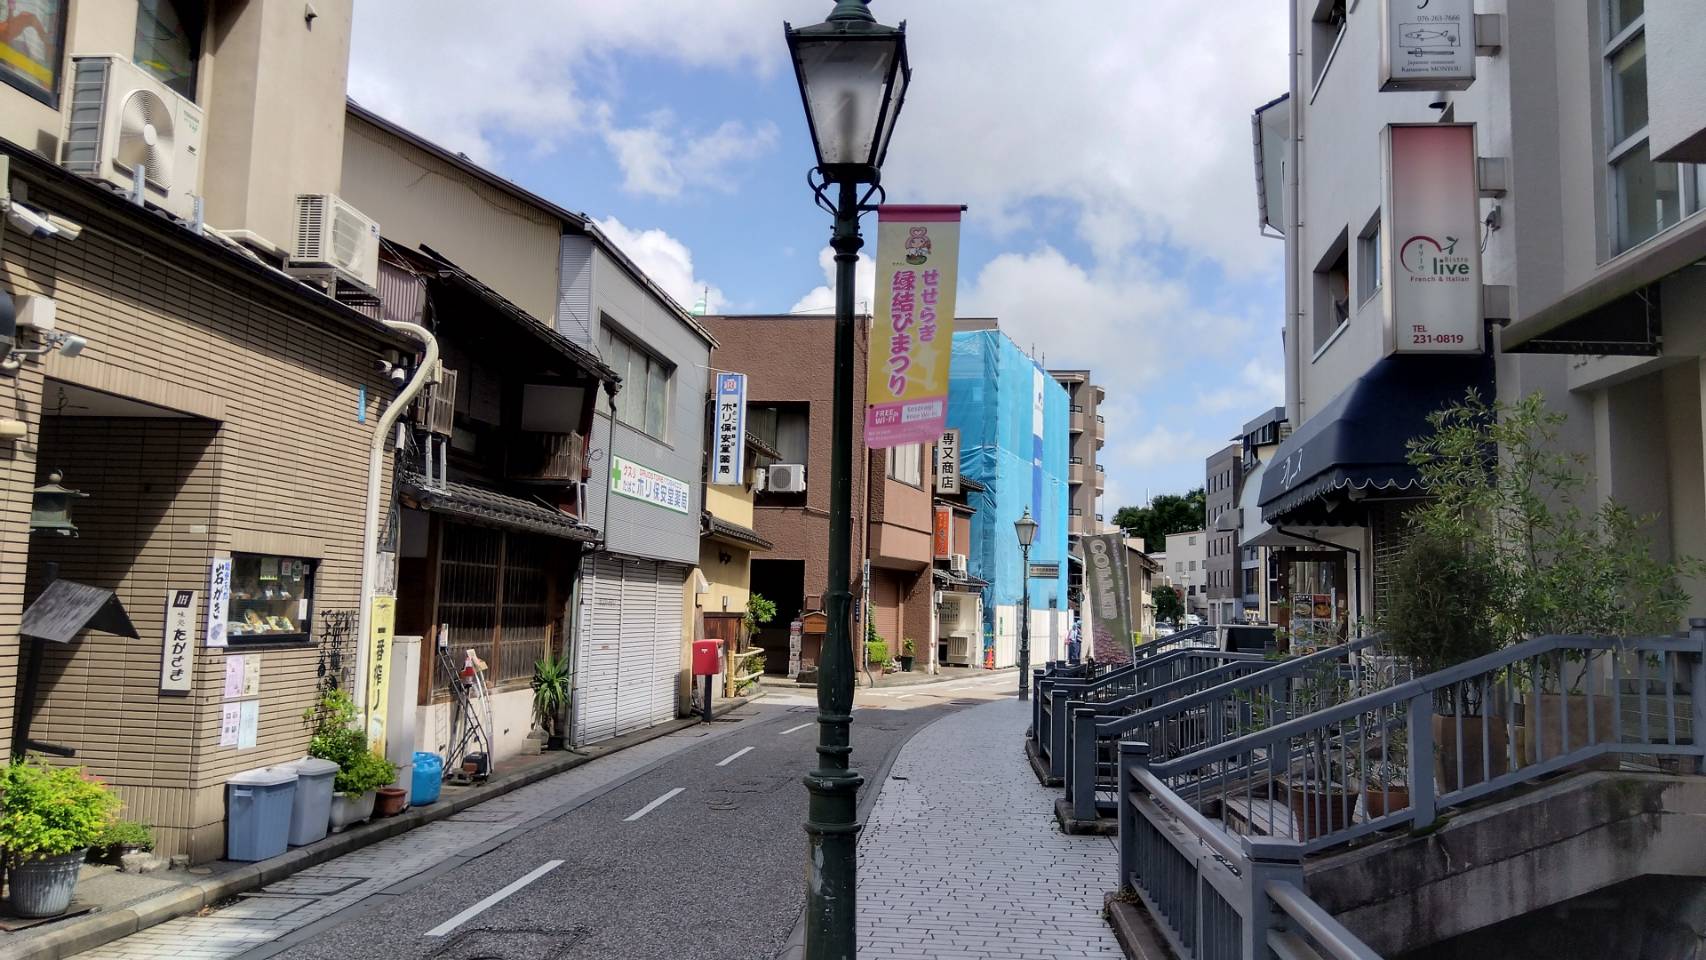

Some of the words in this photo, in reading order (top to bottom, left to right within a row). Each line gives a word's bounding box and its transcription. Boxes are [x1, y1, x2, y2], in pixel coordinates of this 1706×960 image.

[1410, 275, 1436, 283] French
[918, 268, 939, 342] せせらぎ
[888, 270, 916, 396] 縁結びまつり
[1412, 324, 1427, 333] TEL
[1413, 334, 1464, 344] 231-0819
[875, 408, 895, 418] FREE
[718, 402, 733, 474] ホリ保安堂薬局
[942, 432, 955, 489] 専又商店
[637, 478, 688, 511] ホリ保安堂薬局
